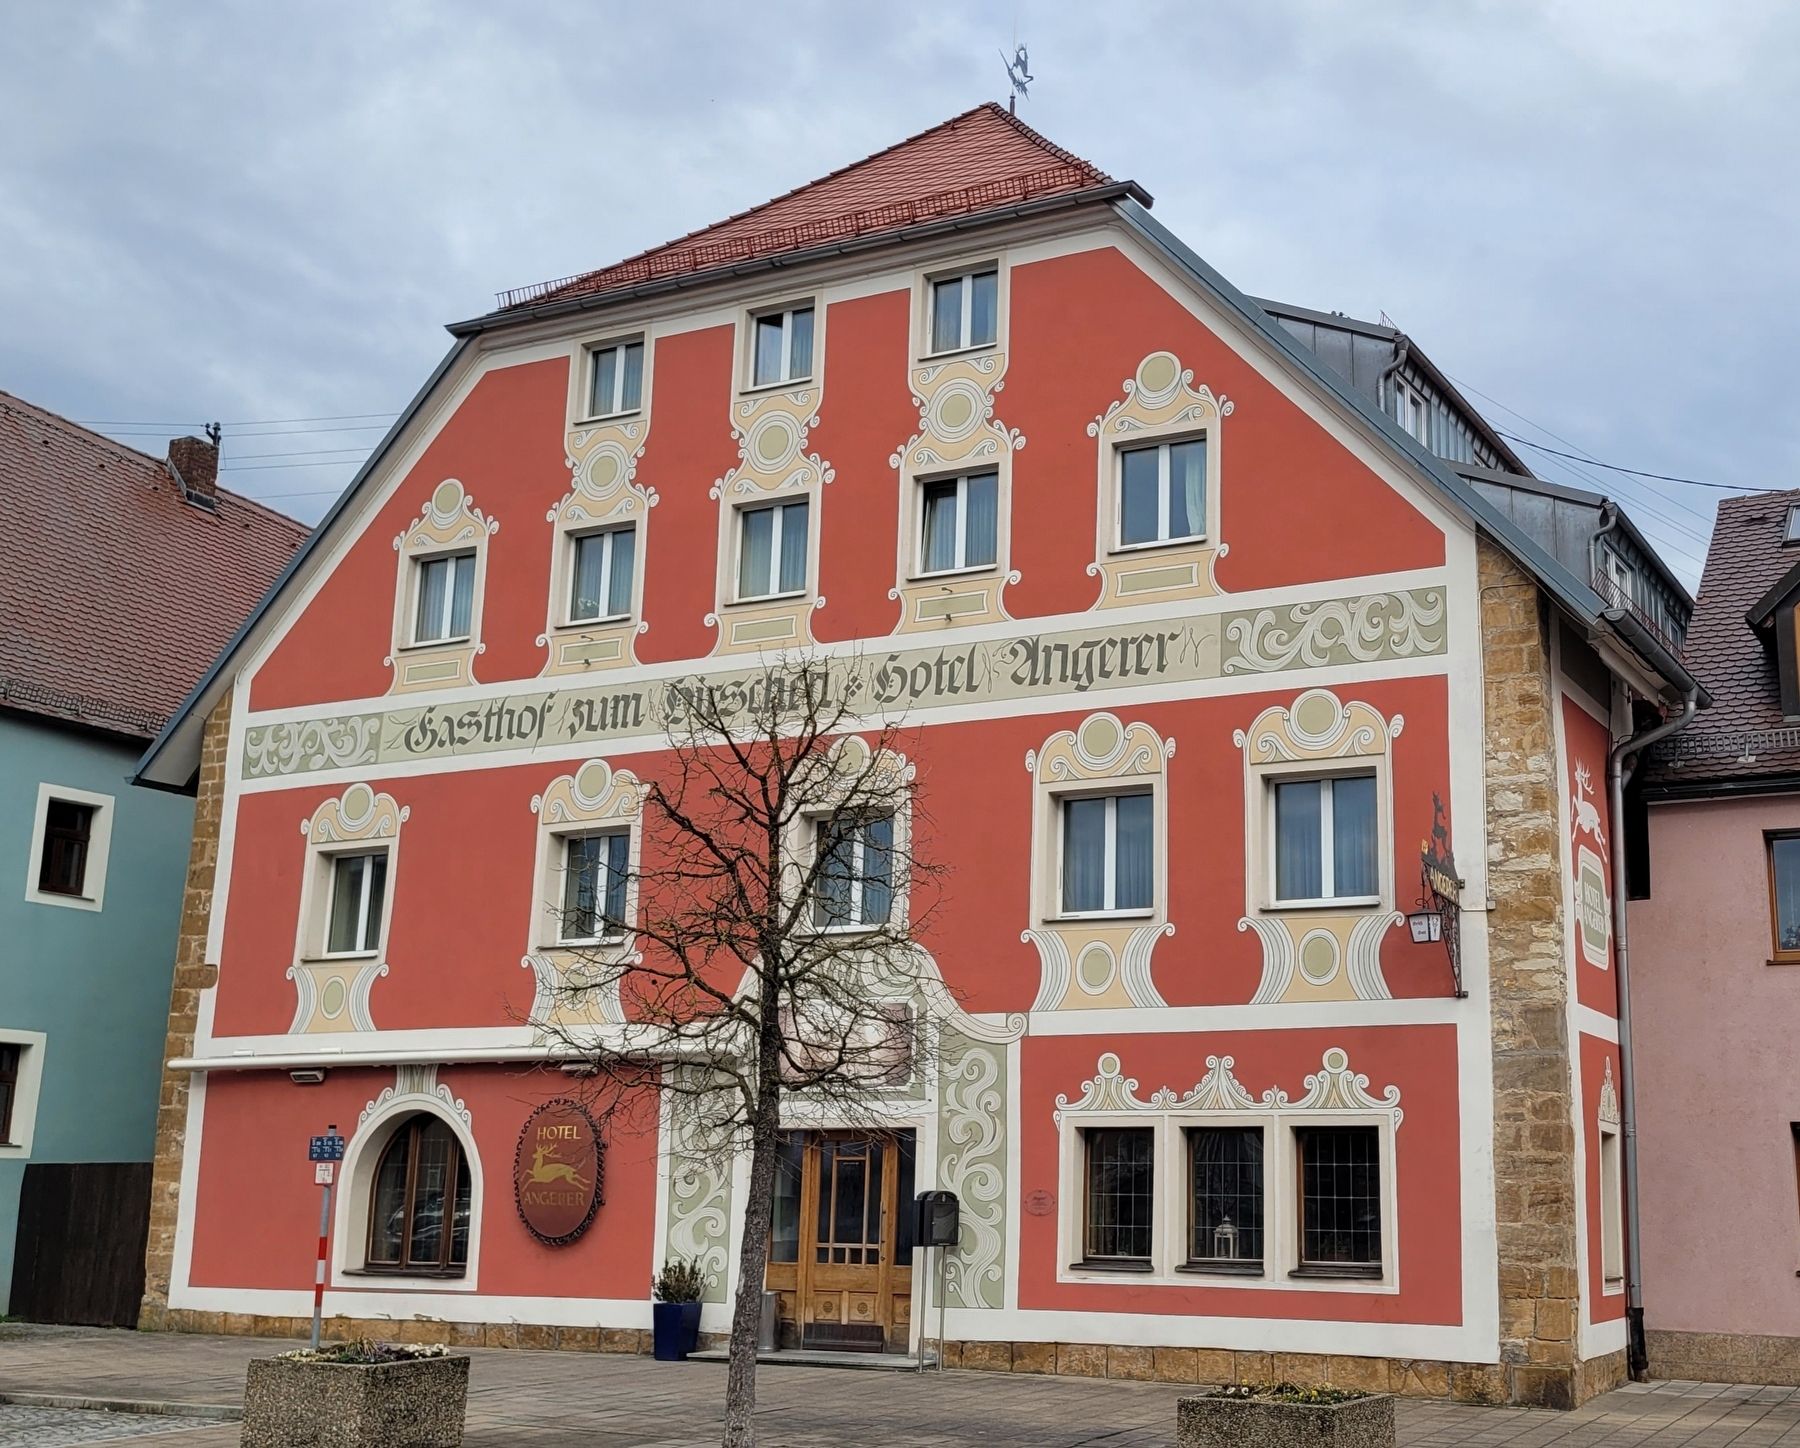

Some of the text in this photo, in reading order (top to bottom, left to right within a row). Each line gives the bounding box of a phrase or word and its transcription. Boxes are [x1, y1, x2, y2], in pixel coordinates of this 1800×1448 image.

[404, 689, 558, 754] Gasthof
[568, 693, 645, 740] zum
[872, 642, 979, 704] Hotel
[1004, 628, 1182, 692] Angerer
[537, 1125, 582, 1140] HOTEL
[524, 1192, 585, 1207] ANGERER
